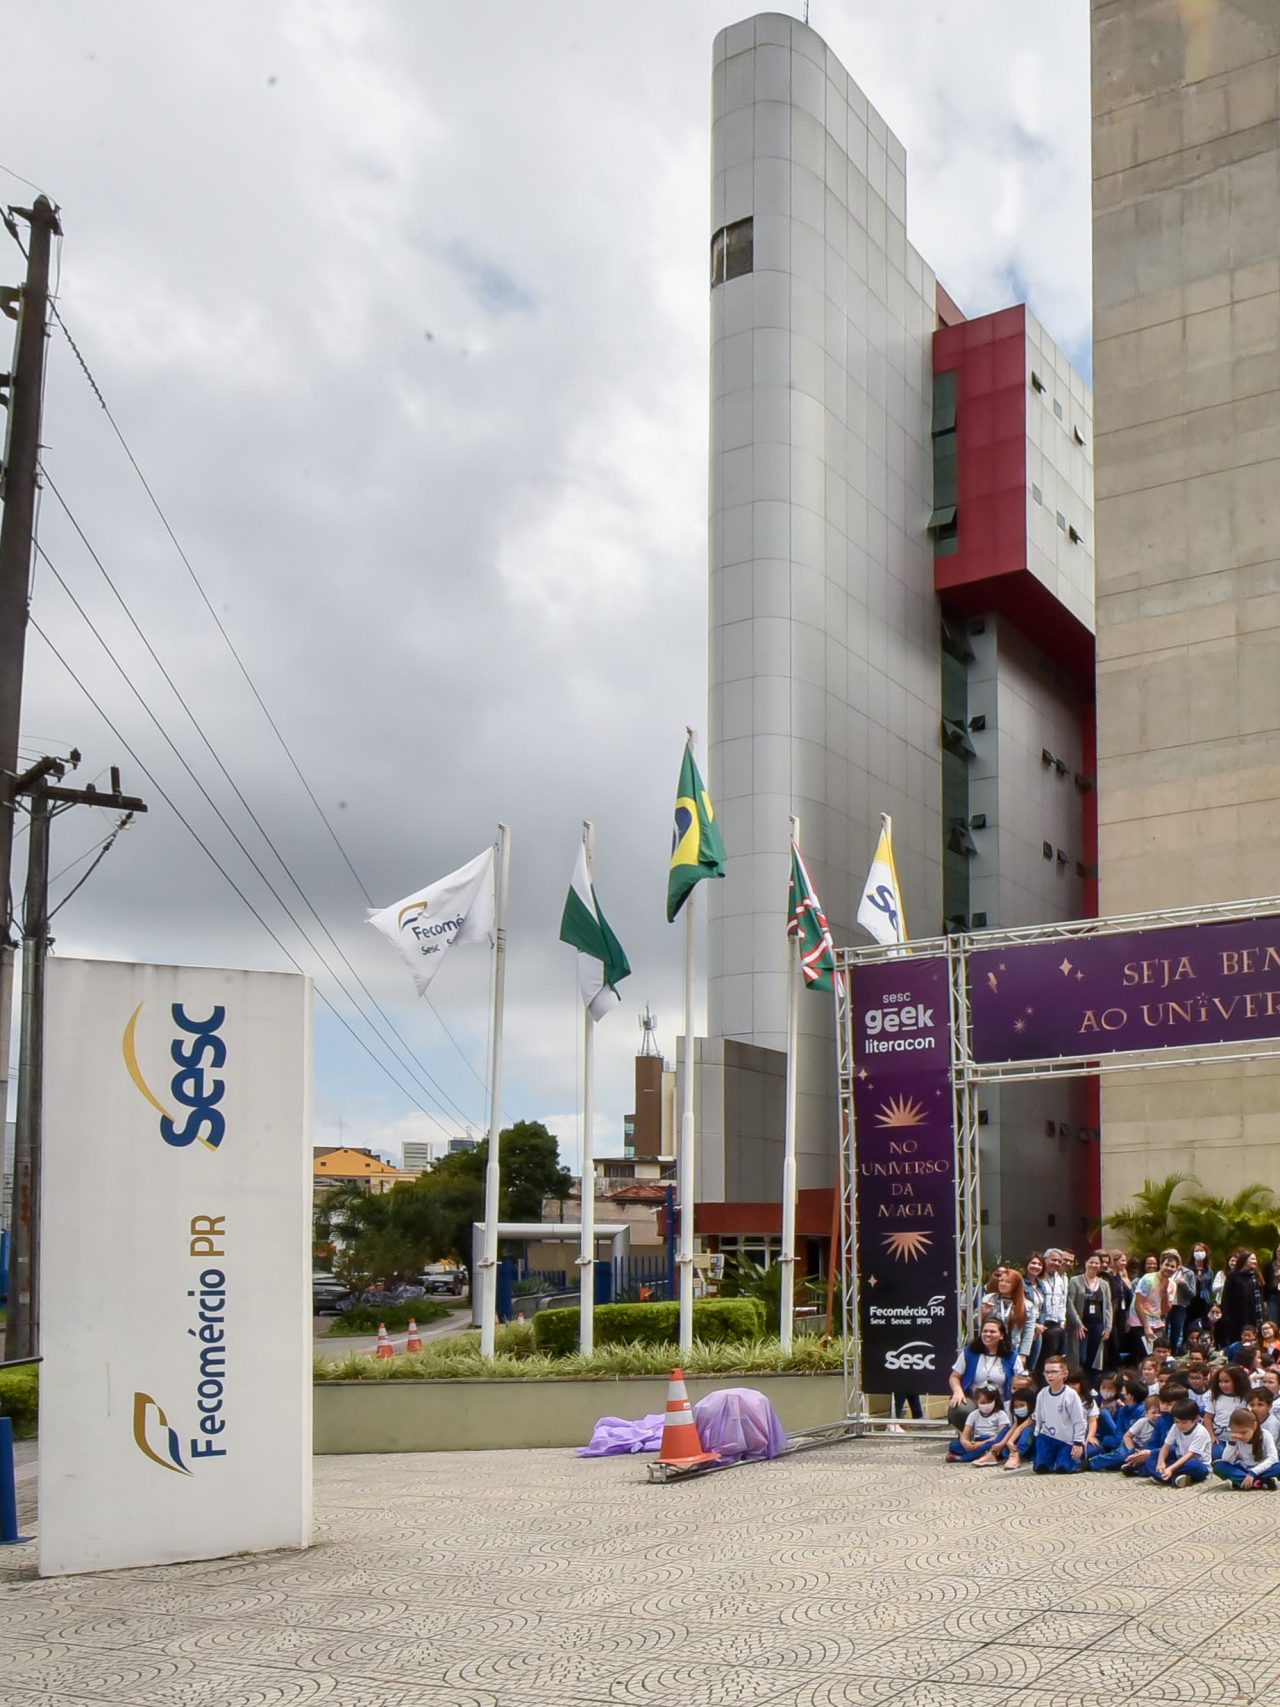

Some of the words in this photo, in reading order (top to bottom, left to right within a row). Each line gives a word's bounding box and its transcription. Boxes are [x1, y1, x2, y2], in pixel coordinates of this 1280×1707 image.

[1122, 956, 1197, 988] SEJA
[882, 992, 912, 1004] sesc
[864, 1004, 935, 1035] geek
[1078, 1007, 1128, 1033] AO
[865, 1036, 936, 1054] literacon
[159, 1002, 227, 1151] Sesc
[889, 1140, 918, 1155] NO
[861, 1160, 949, 1176] UNIVERSO
[891, 1183, 914, 1197] DA
[190, 1215, 226, 1257] PR
[869, 1305, 928, 1316] Fecomércio
[930, 1306, 945, 1316] PR
[187, 1268, 227, 1459] Fecomércio
[884, 1350, 936, 1370] Sesc
